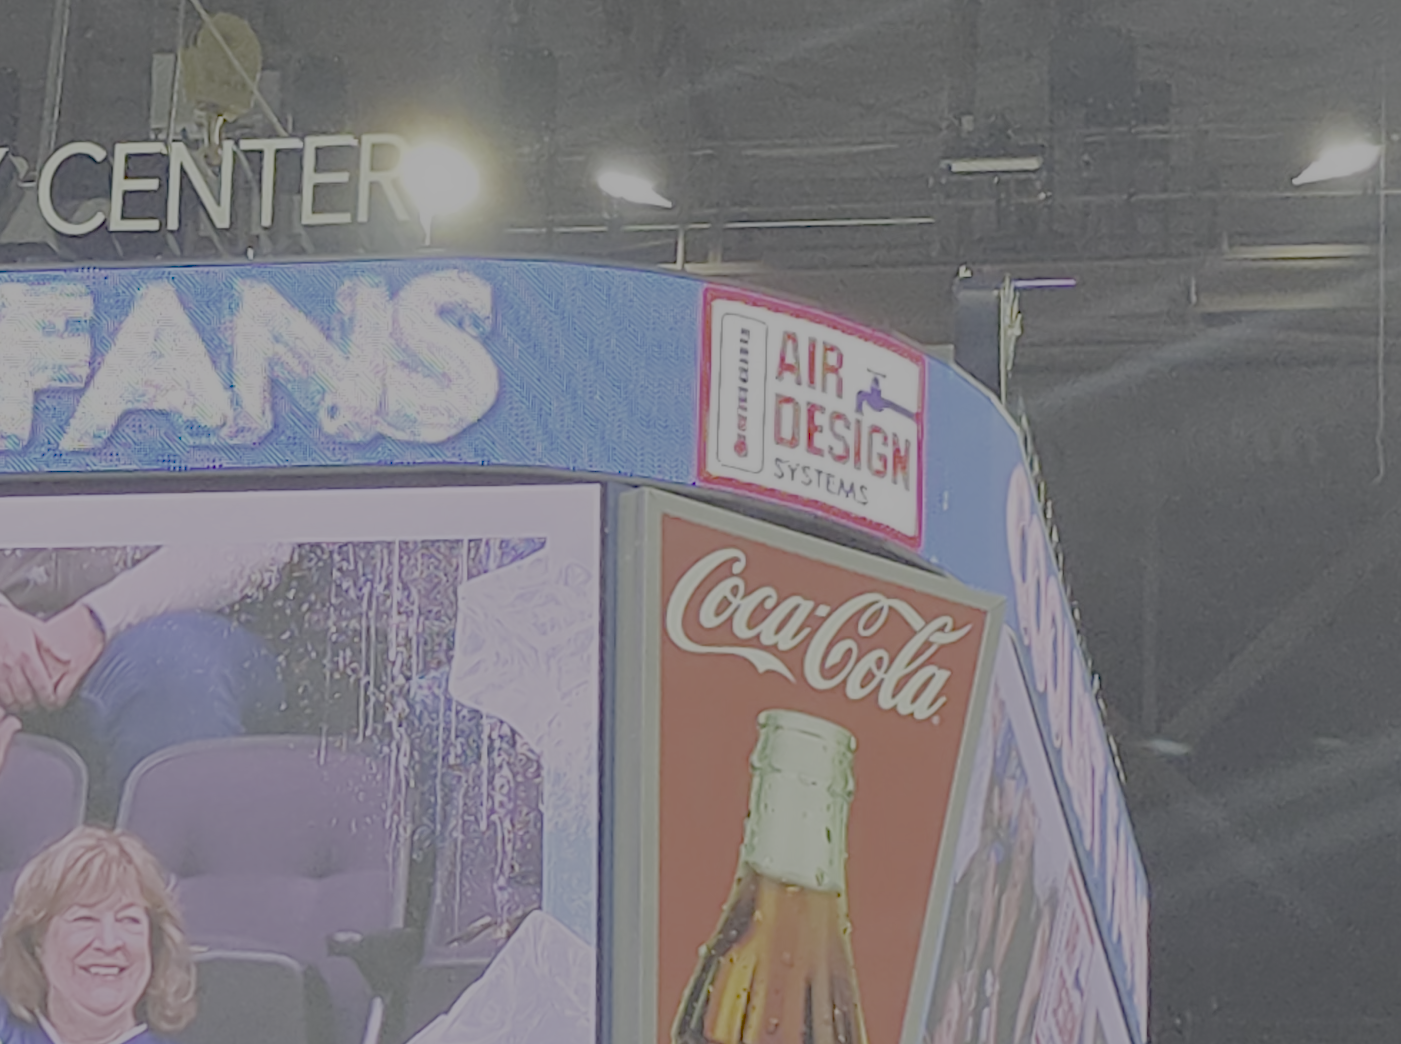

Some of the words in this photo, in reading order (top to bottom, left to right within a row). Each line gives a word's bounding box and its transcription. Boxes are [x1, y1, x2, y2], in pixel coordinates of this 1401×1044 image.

[37, 134, 411, 236] CENTER
[775, 330, 844, 399] AIR
[773, 392, 911, 491] DESIGN
[773, 456, 869, 506] SYSTEMS
[665, 547, 973, 721] Coca-Cola
